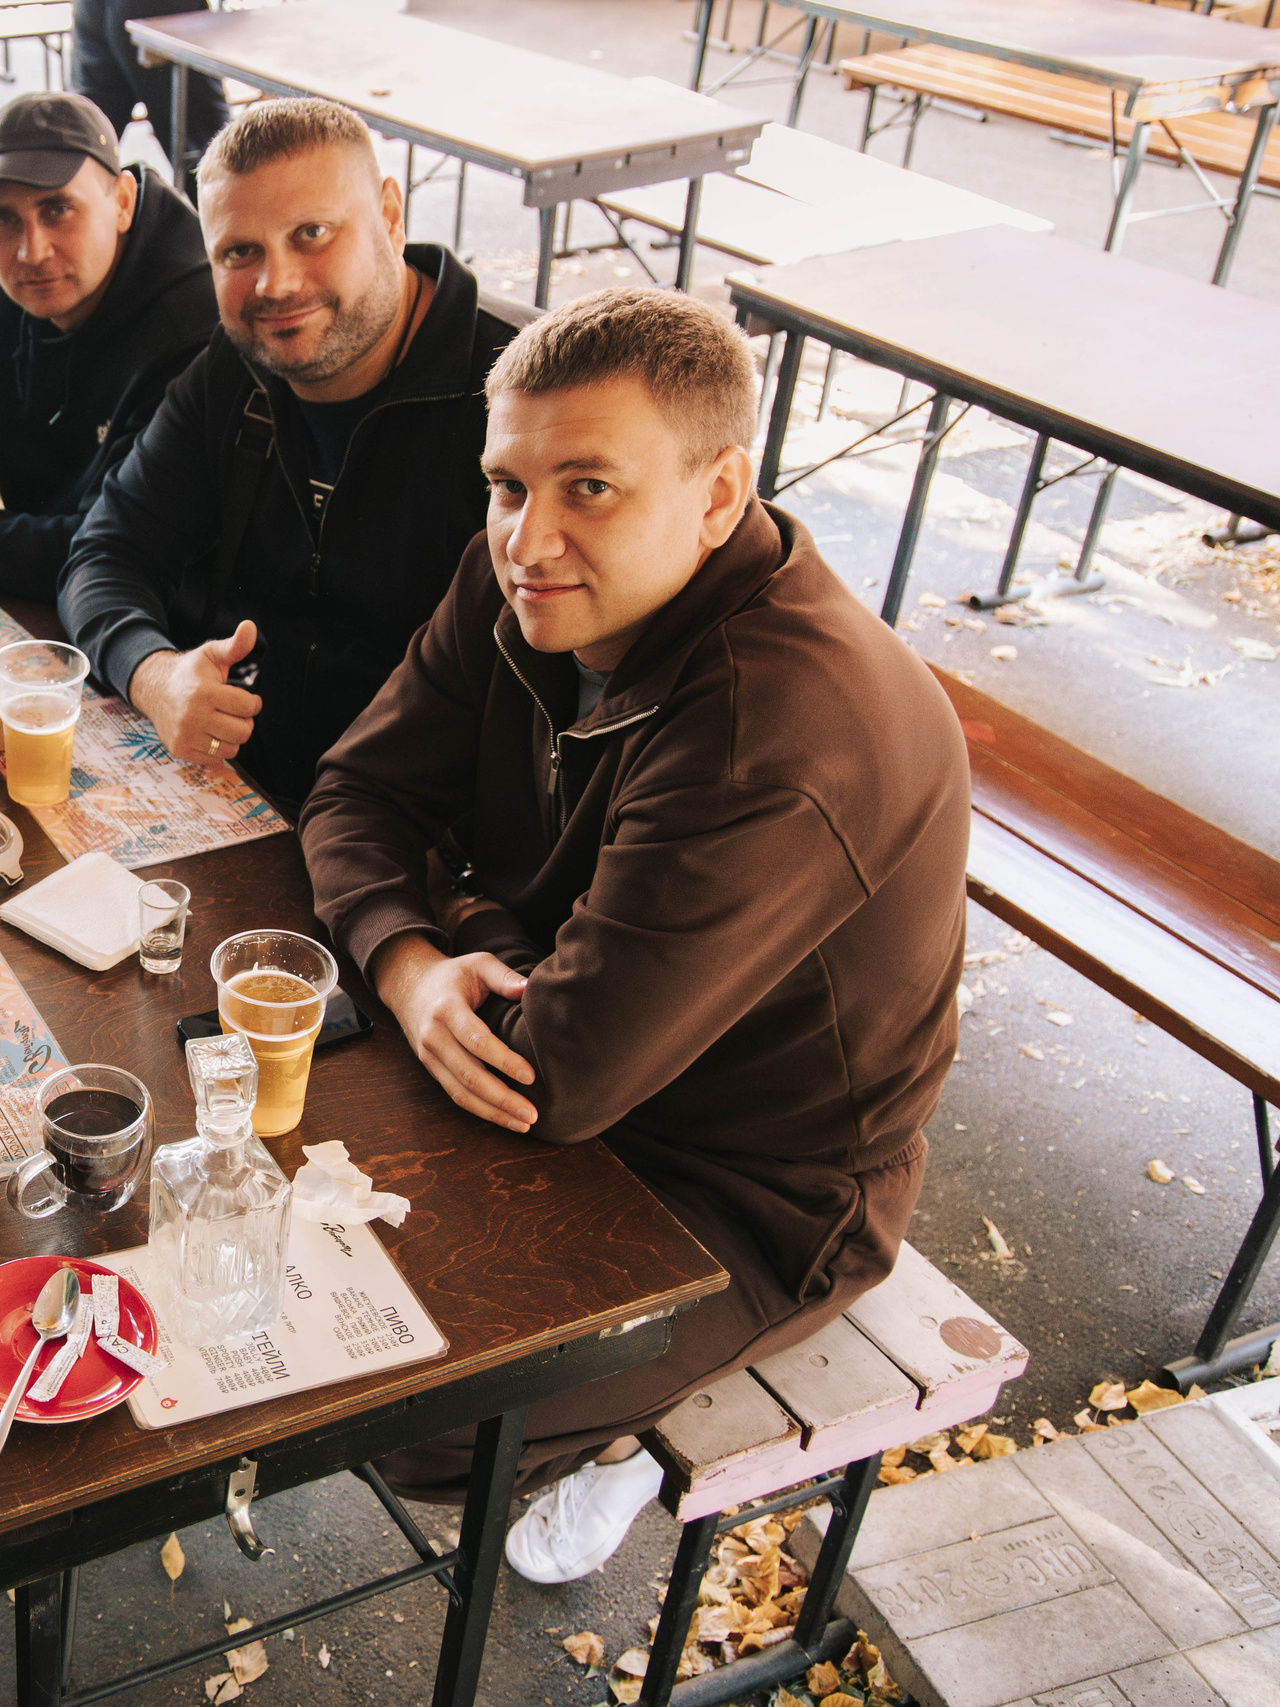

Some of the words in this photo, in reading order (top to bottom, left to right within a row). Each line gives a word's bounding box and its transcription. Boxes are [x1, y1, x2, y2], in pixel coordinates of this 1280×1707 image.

[328, 1290, 352, 1320] ВИШНЕВОЕ
[348, 1321, 363, 1338] ПИВО
[339, 1292, 358, 1314] ВАСЬКА
[345, 1286, 364, 1309] ВАКАНО
[360, 1310, 379, 1333] ТЕМНОЕ
[333, 1313, 355, 1340] ВЕНСКОЕ
[379, 1305, 416, 1346] ПИВО
[207, 1346, 227, 1371] GINGER
[216, 1343, 236, 1370] SPORTY
[229, 1349, 245, 1367] POSH
[238, 1347, 253, 1364] BABY
[244, 1341, 262, 1363] JOLLY
[250, 1330, 291, 1381] ТЕЙЛИ
[870, 1567, 968, 1622] 2018
